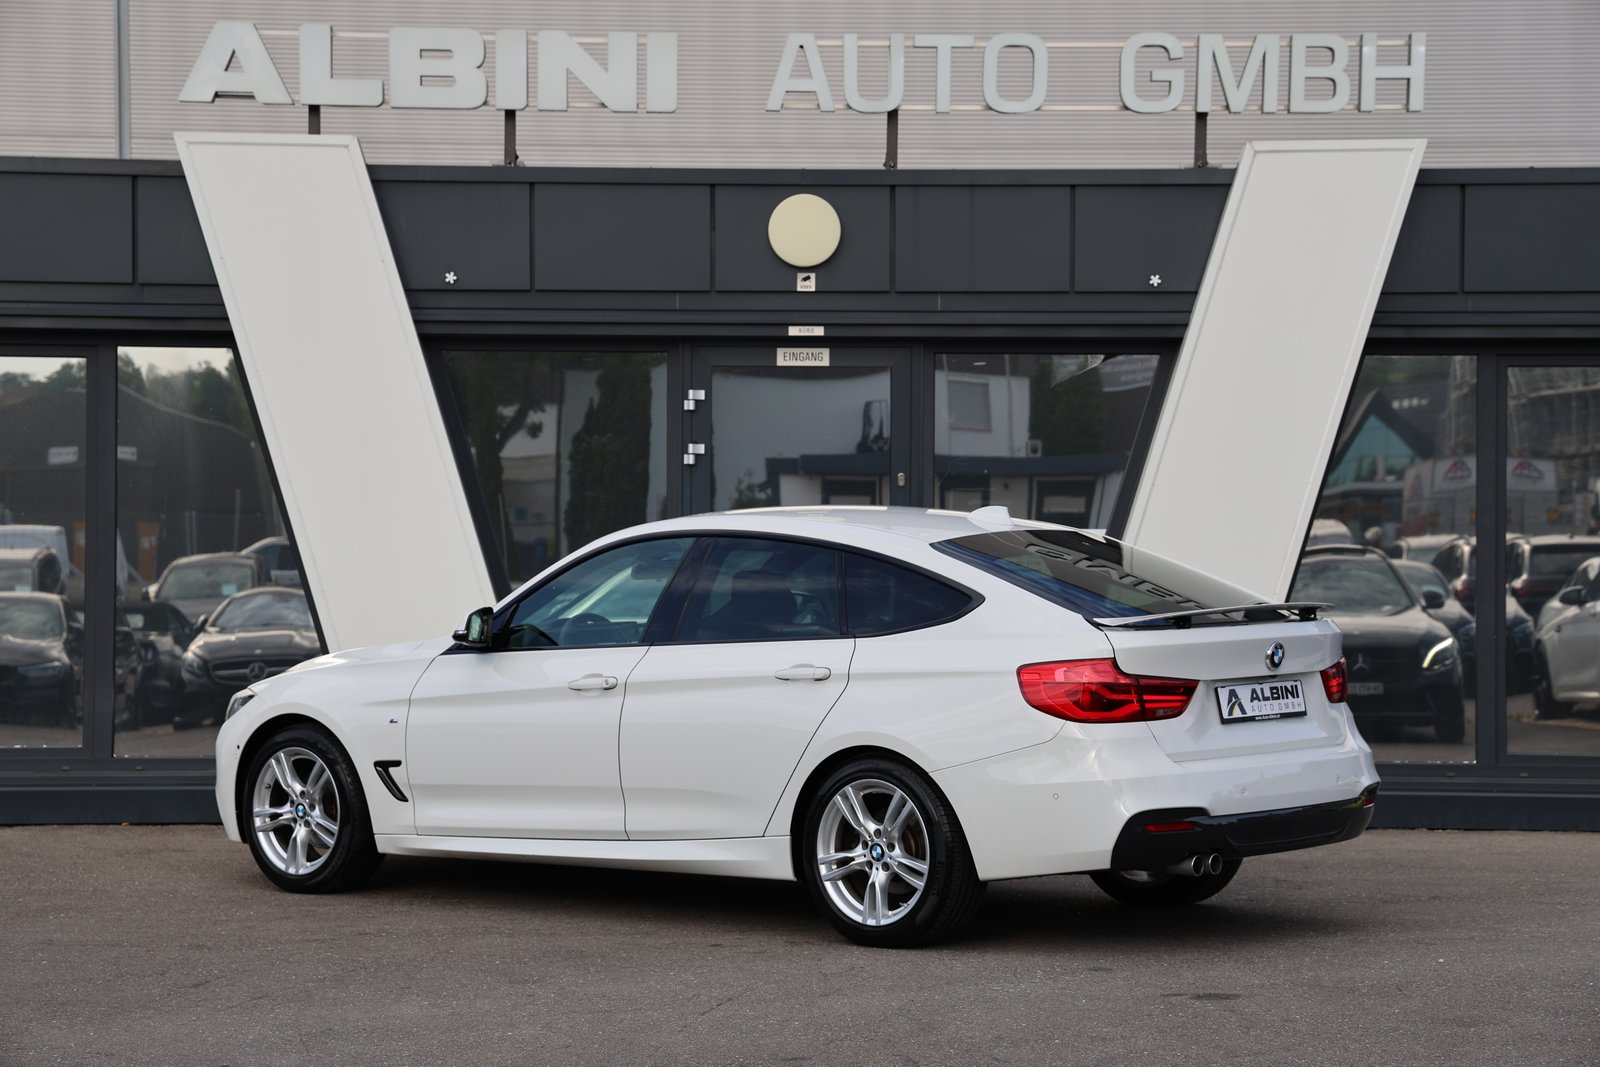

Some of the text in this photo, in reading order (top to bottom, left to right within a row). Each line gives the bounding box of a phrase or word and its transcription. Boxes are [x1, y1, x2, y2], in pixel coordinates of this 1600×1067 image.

[178, 21, 1427, 114] ALBINI AUTO GMBH
[783, 351, 824, 362] EINGANG
[1250, 684, 1300, 703] ALBINI
[1251, 701, 1302, 713] AUTO GMBH
